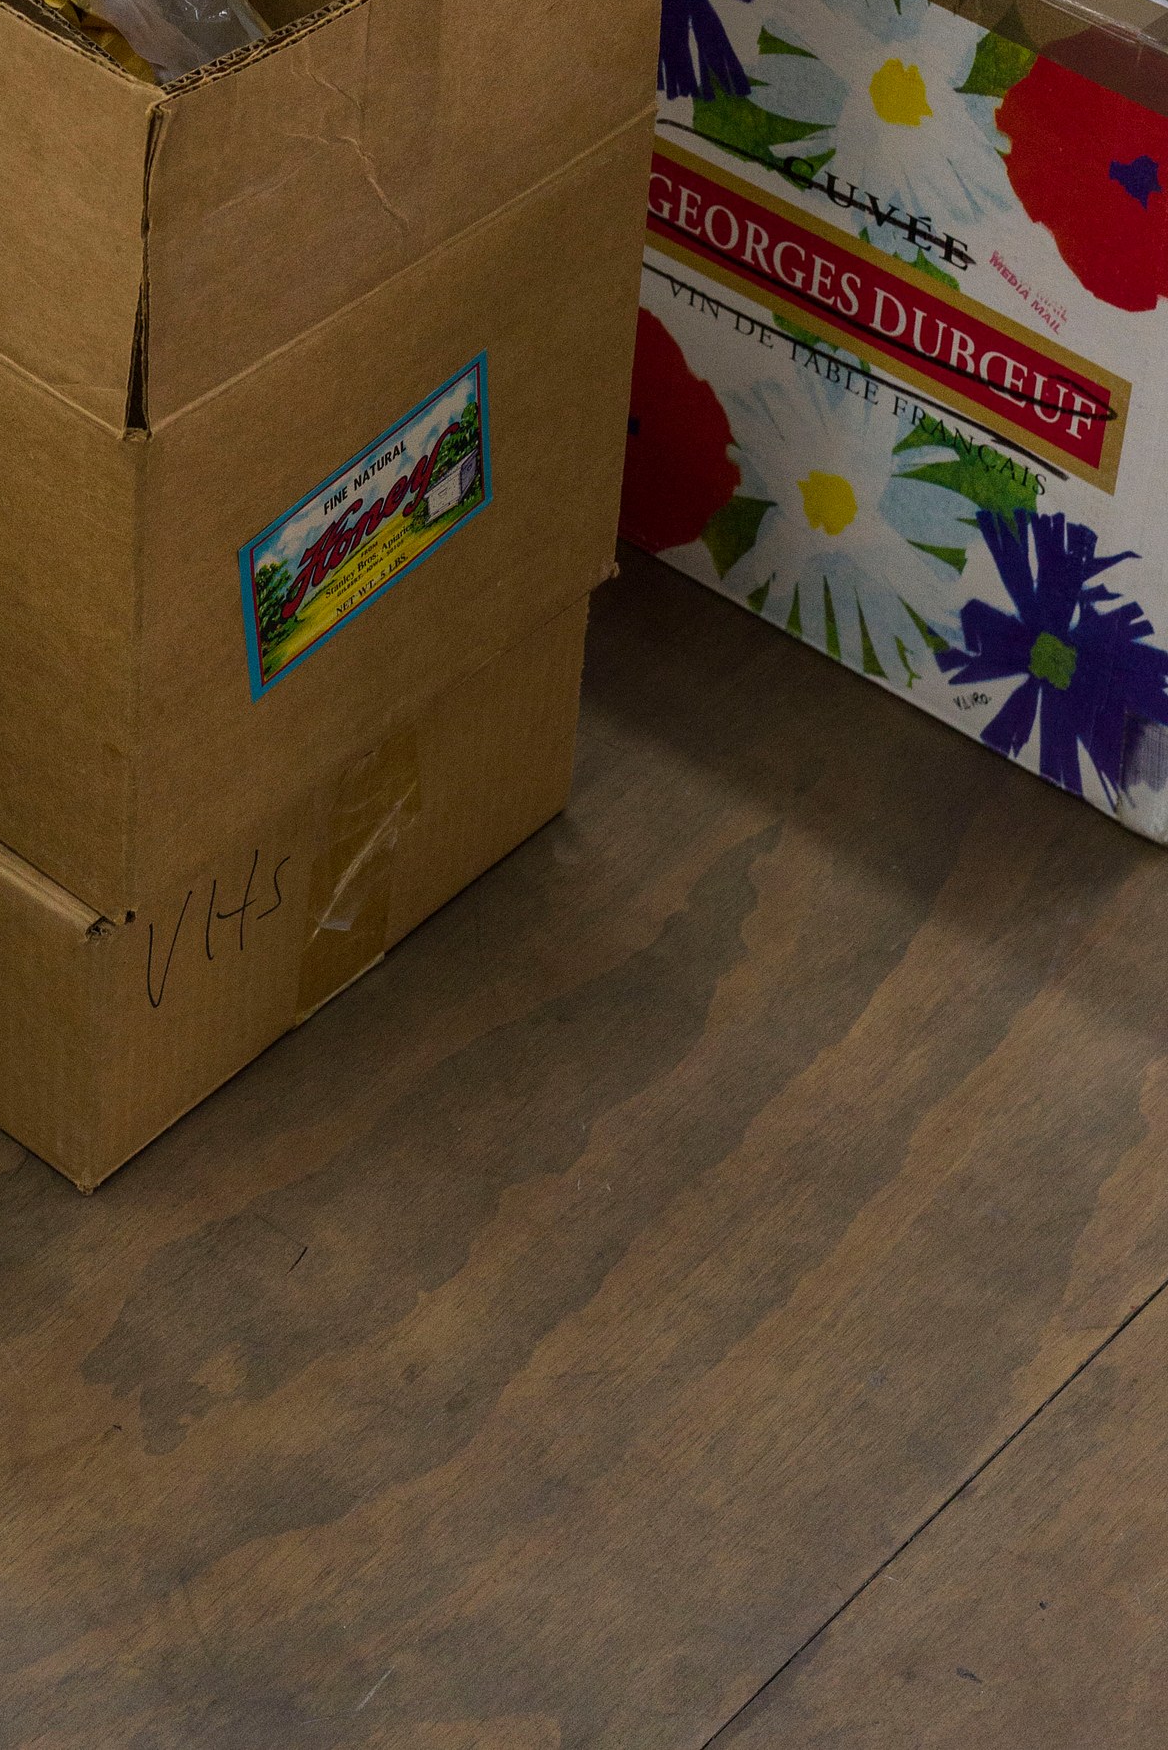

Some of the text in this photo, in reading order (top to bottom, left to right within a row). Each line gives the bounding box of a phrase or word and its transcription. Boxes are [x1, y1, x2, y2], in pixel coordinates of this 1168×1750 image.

[646, 170, 1099, 443] GEORGES DUBŒUF
[988, 249, 1030, 301] MEDIA
[1029, 299, 1062, 336] MAIL
[666, 275, 1048, 498] VIN DE TABLE FRANÇAIS
[282, 420, 461, 620] Honey
[323, 439, 408, 517] FINE NATURAL
[325, 570, 356, 600] Stanley
[357, 553, 380, 573] Bros.
[336, 596, 356, 617] NET
[388, 552, 409, 574] LBS.
[147, 849, 291, 1009] VHS
